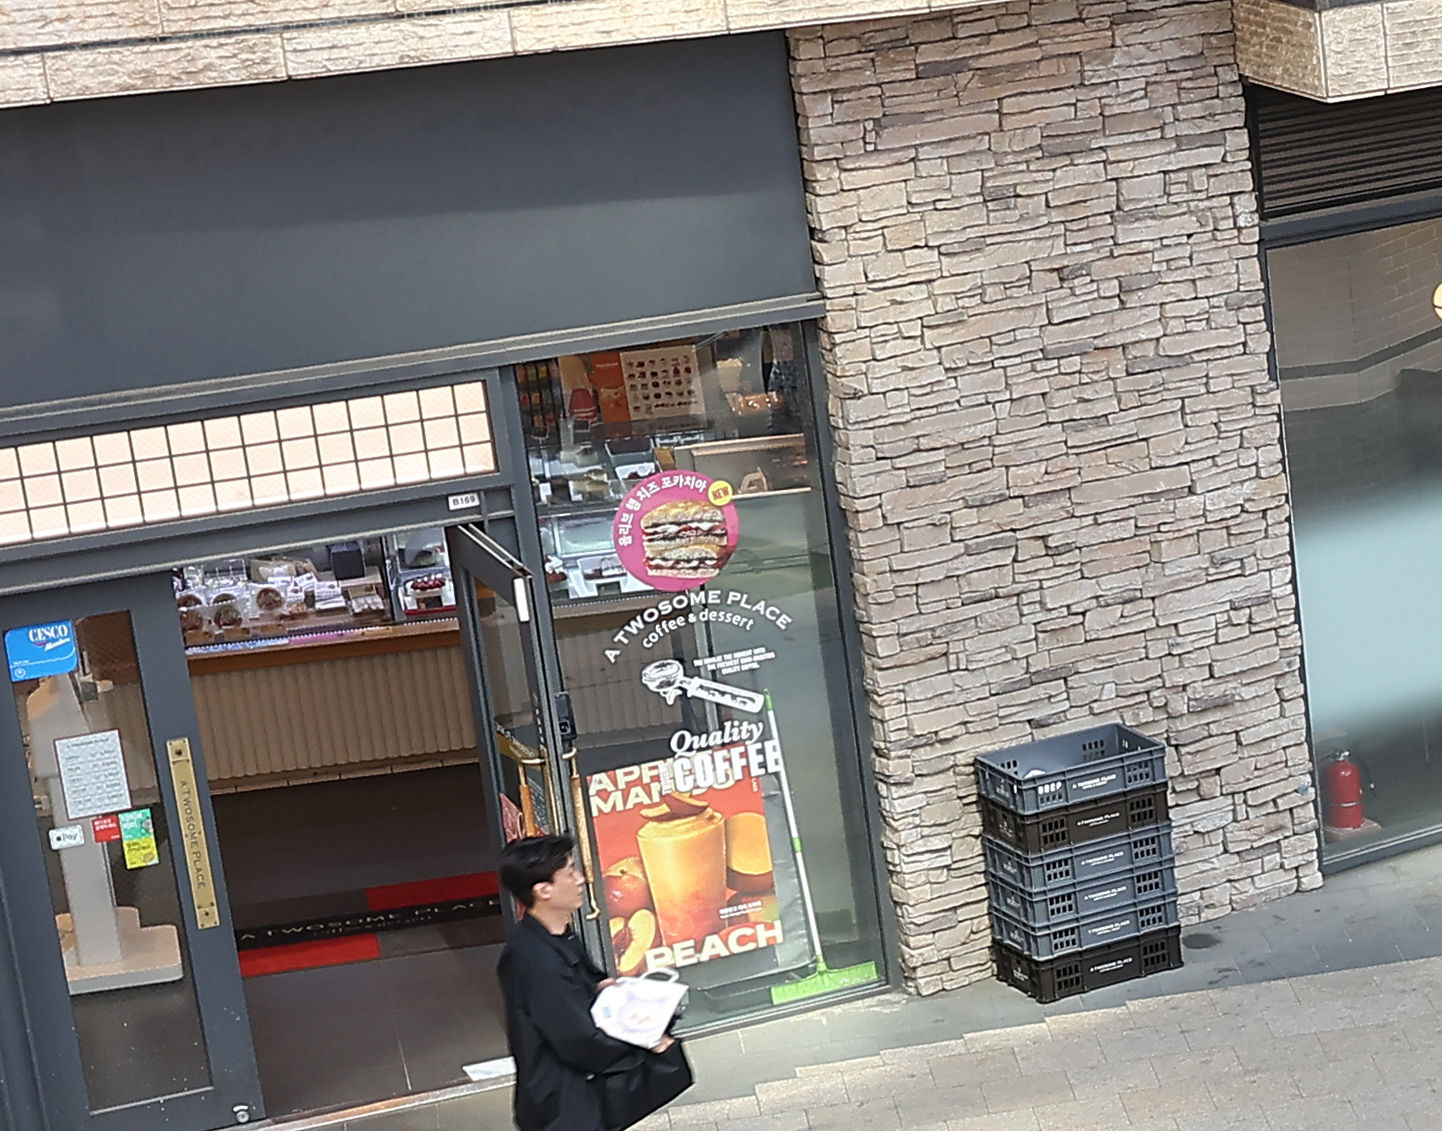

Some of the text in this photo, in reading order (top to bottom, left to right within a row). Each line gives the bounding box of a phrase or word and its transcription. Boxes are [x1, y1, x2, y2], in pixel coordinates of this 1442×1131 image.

[635, 474, 708, 501] 치즈 포카치아
[711, 487, 730, 501] NEW
[28, 624, 69, 643] CESCO
[604, 590, 793, 664] A TWOSOME PLACE
[642, 608, 755, 649] coffee & dessert
[670, 721, 764, 759] Quality
[672, 740, 785, 794] COFFEE
[62, 833, 78, 843] Pay
[179, 780, 207, 889] A TWOSOME PLACE
[645, 920, 784, 972] PEACH
